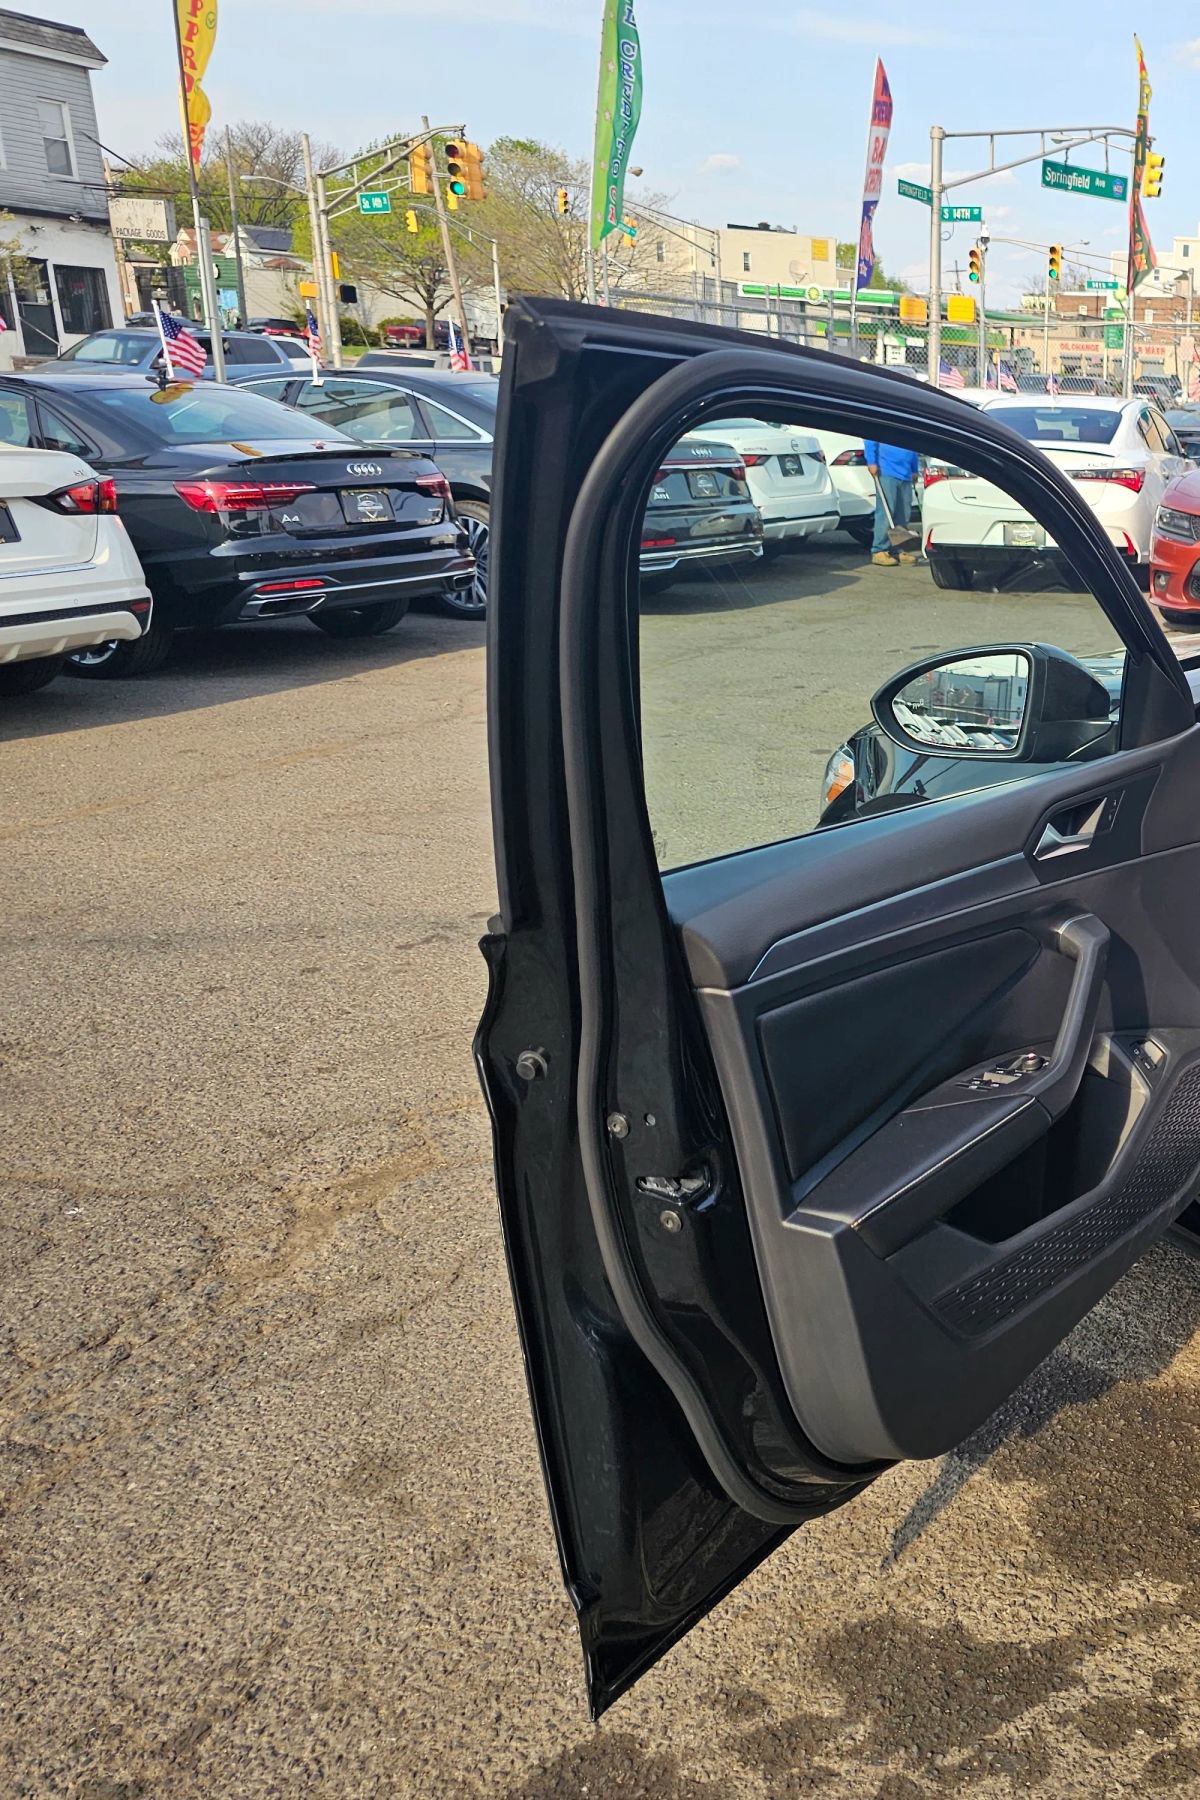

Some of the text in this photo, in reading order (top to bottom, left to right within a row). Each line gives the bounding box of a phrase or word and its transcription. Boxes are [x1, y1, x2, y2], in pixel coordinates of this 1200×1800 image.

[1045, 167, 1106, 190] Springfield Ave
[943, 208, 950, 219] S
[953, 208, 971, 220] 14TH
[115, 227, 166, 240] PACKAGE GOODS
[281, 514, 300, 524] A4
